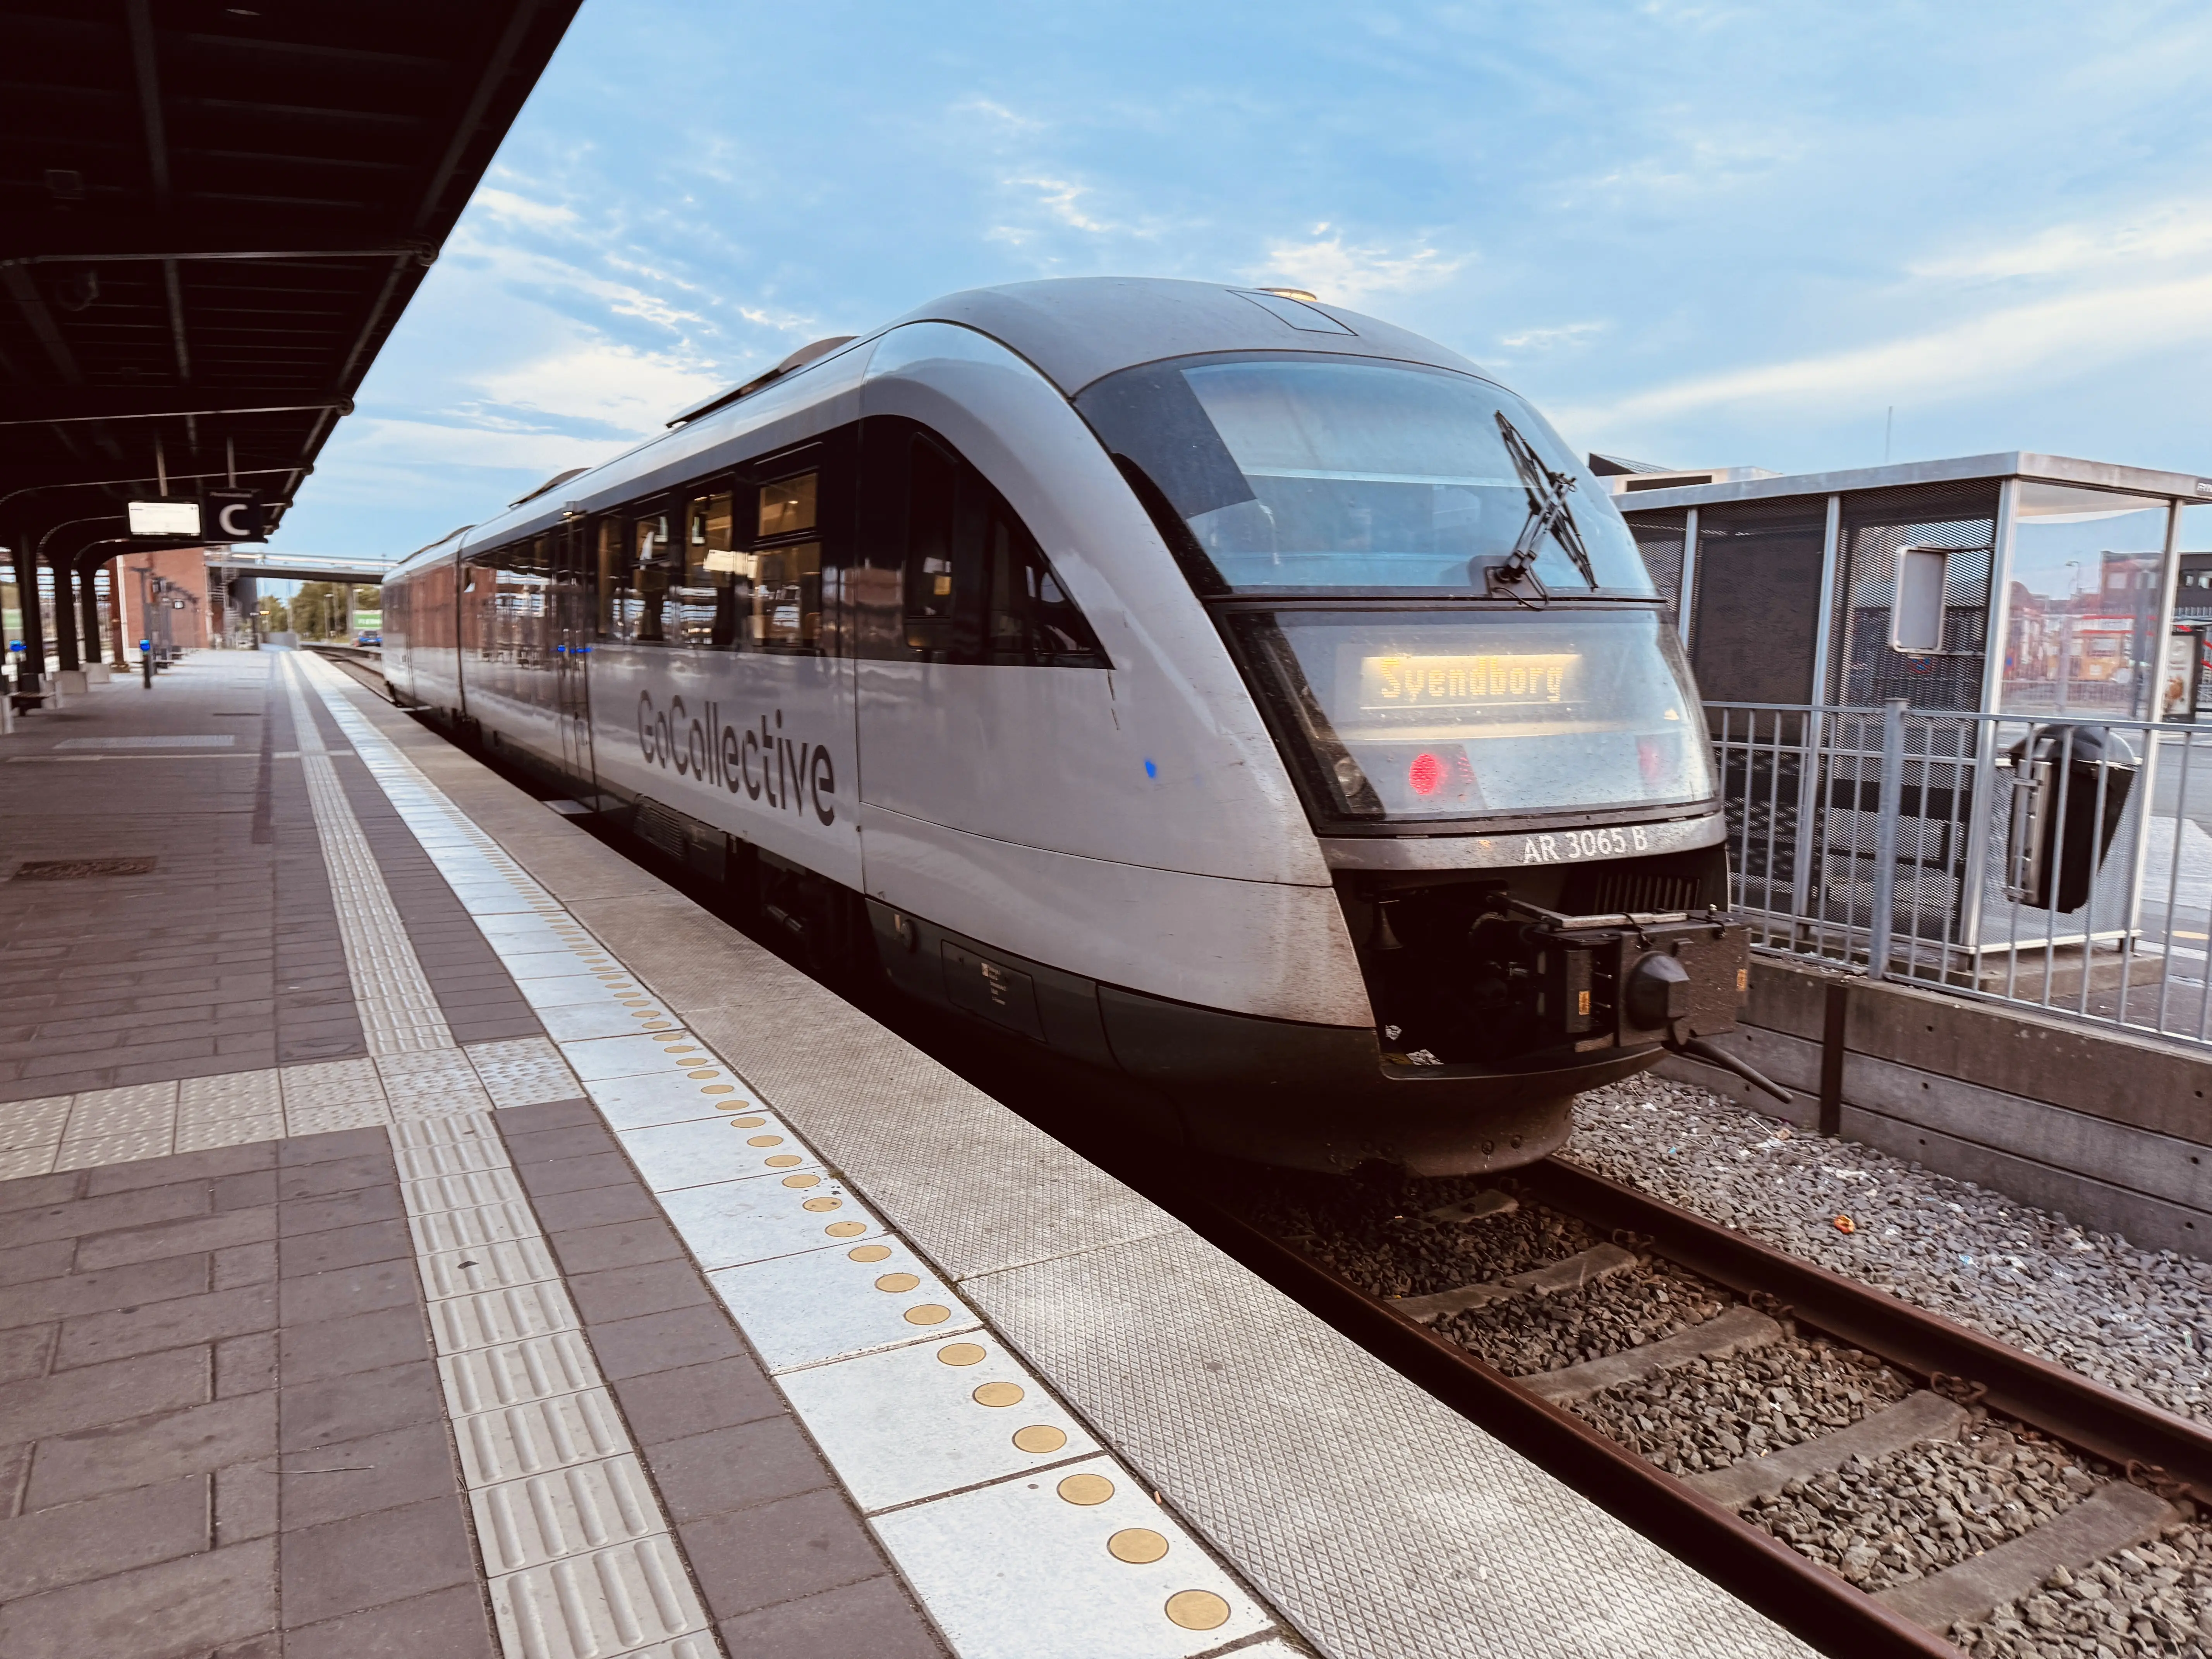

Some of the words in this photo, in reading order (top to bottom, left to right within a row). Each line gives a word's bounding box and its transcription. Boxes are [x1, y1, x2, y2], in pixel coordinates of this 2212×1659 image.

[219, 504, 251, 536] C
[1380, 658, 1563, 701] Svendborg
[637, 689, 835, 826] GoCollective
[1523, 836, 1561, 864] AR
[1565, 828, 1626, 858] 3065
[1632, 826, 1646, 850] B
